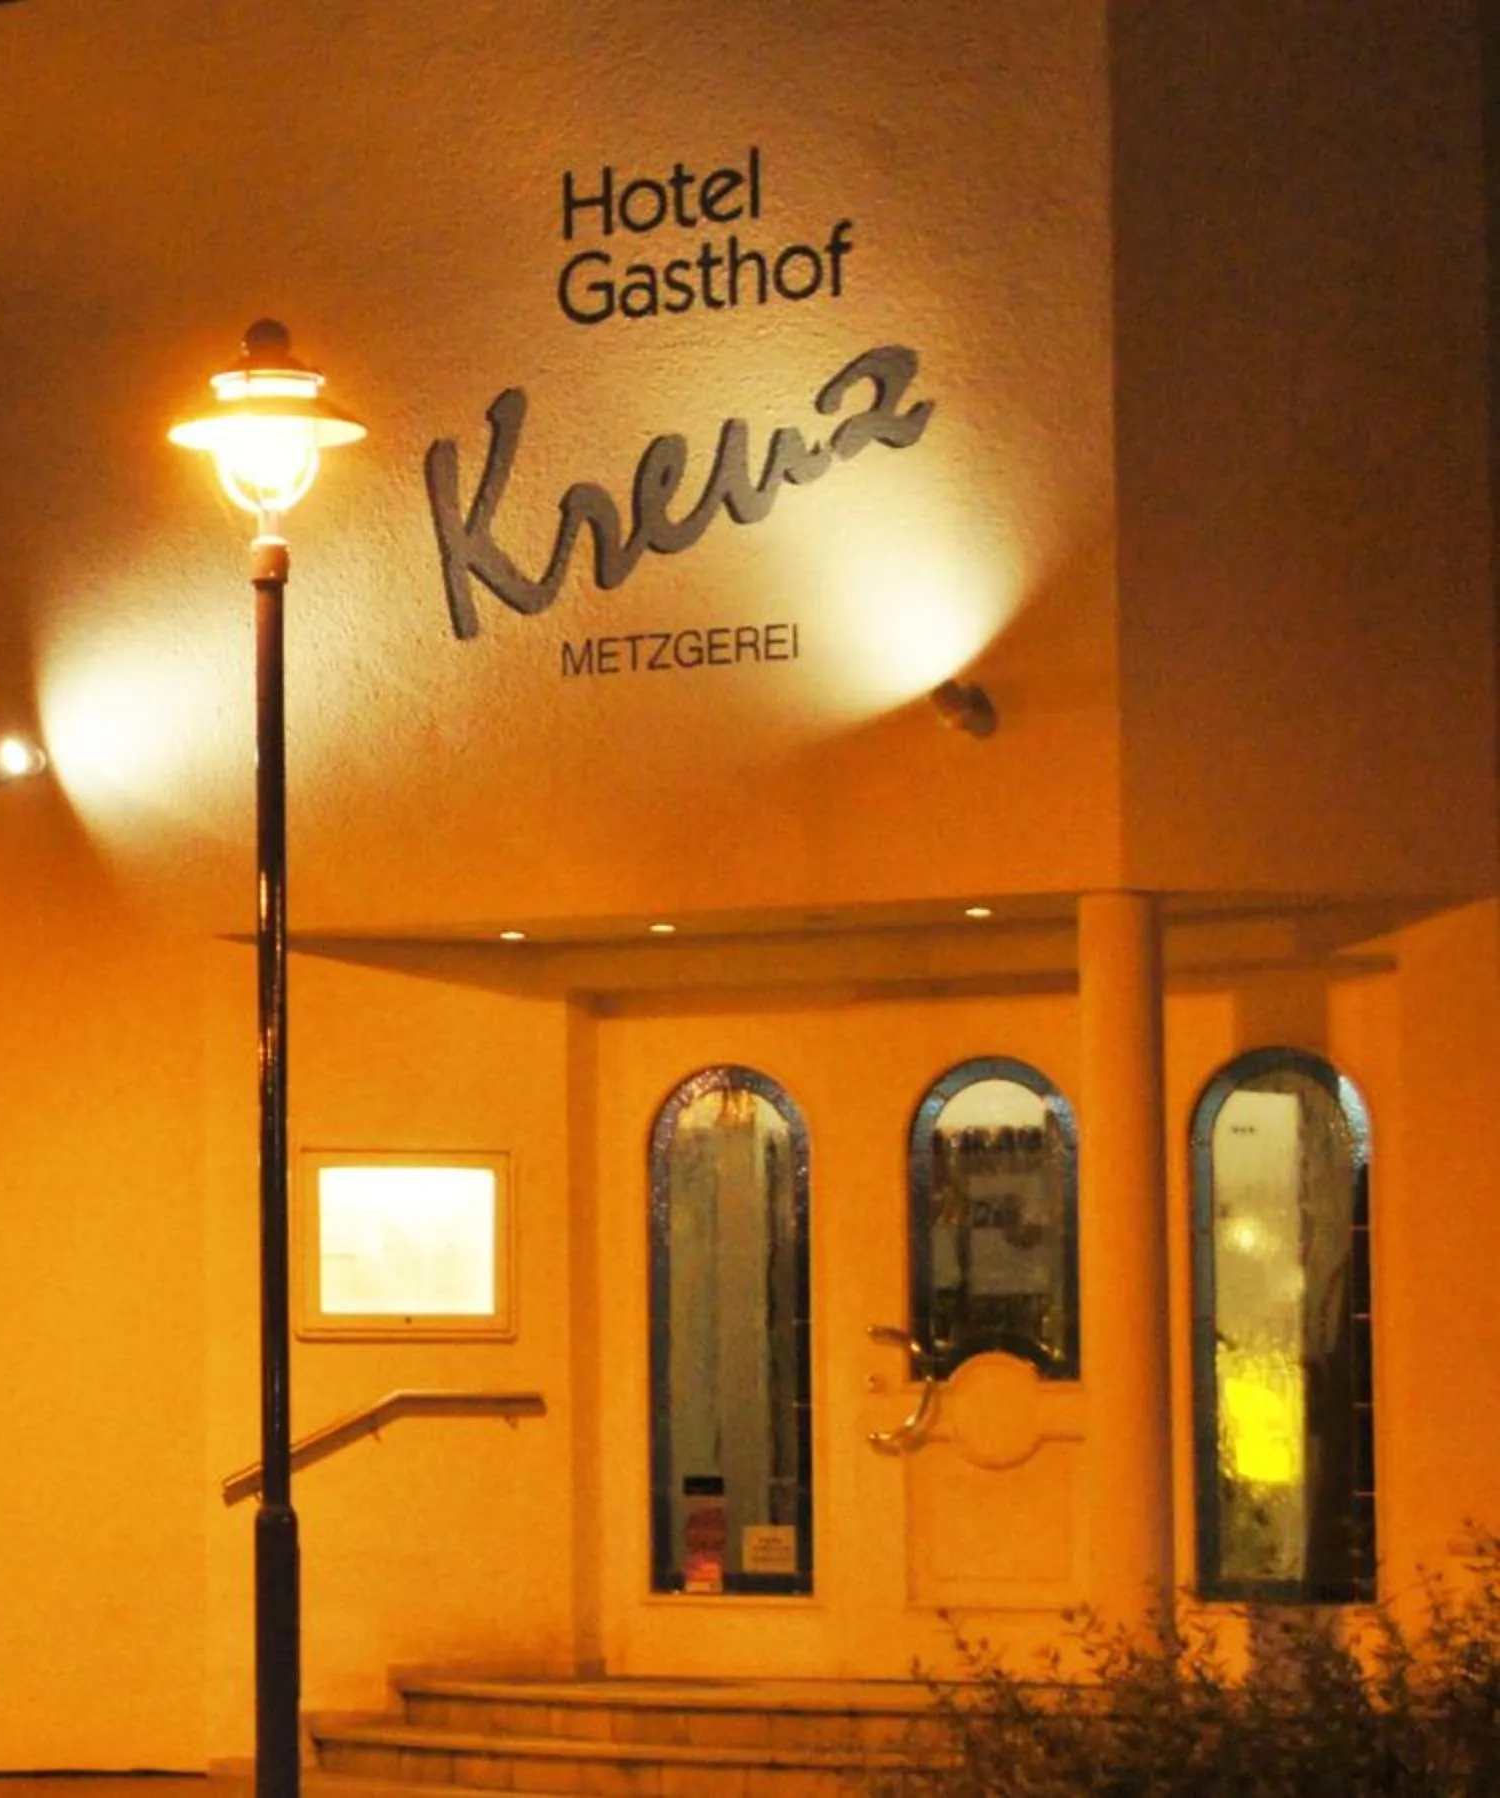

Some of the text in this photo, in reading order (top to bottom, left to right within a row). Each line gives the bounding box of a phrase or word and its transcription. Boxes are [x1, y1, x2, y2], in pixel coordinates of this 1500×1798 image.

[562, 146, 760, 240] Hotel
[557, 219, 853, 324] Gasthof
[424, 344, 936, 641] Kreuz
[561, 623, 799, 676] METZGEREI
